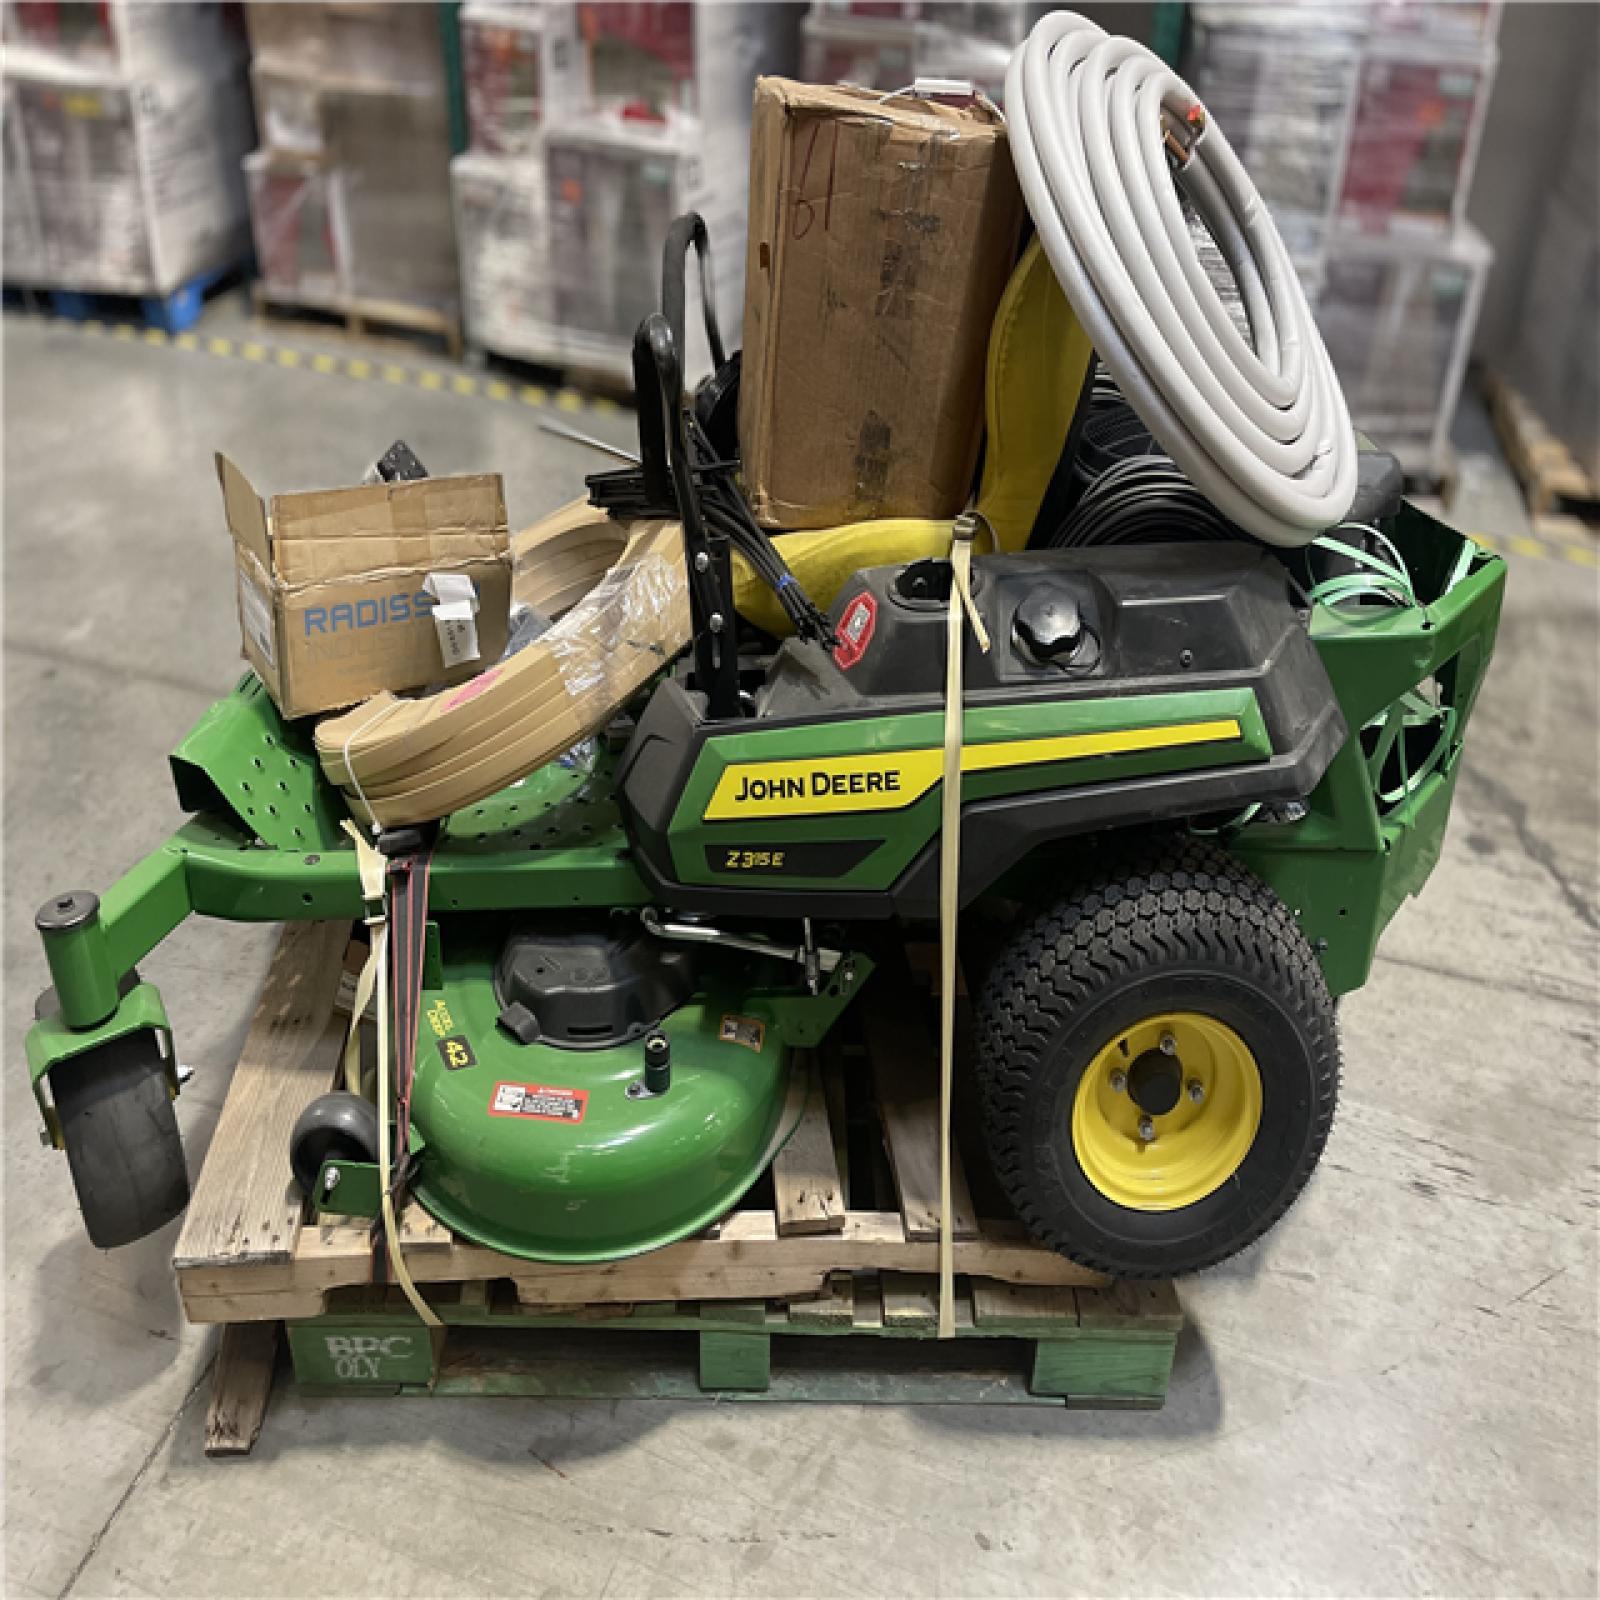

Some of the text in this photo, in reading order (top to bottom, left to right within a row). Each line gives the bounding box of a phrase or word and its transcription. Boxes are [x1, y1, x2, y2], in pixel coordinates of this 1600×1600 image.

[734, 770, 901, 801] JOHN DEERE
[446, 1041, 469, 1068] 42
